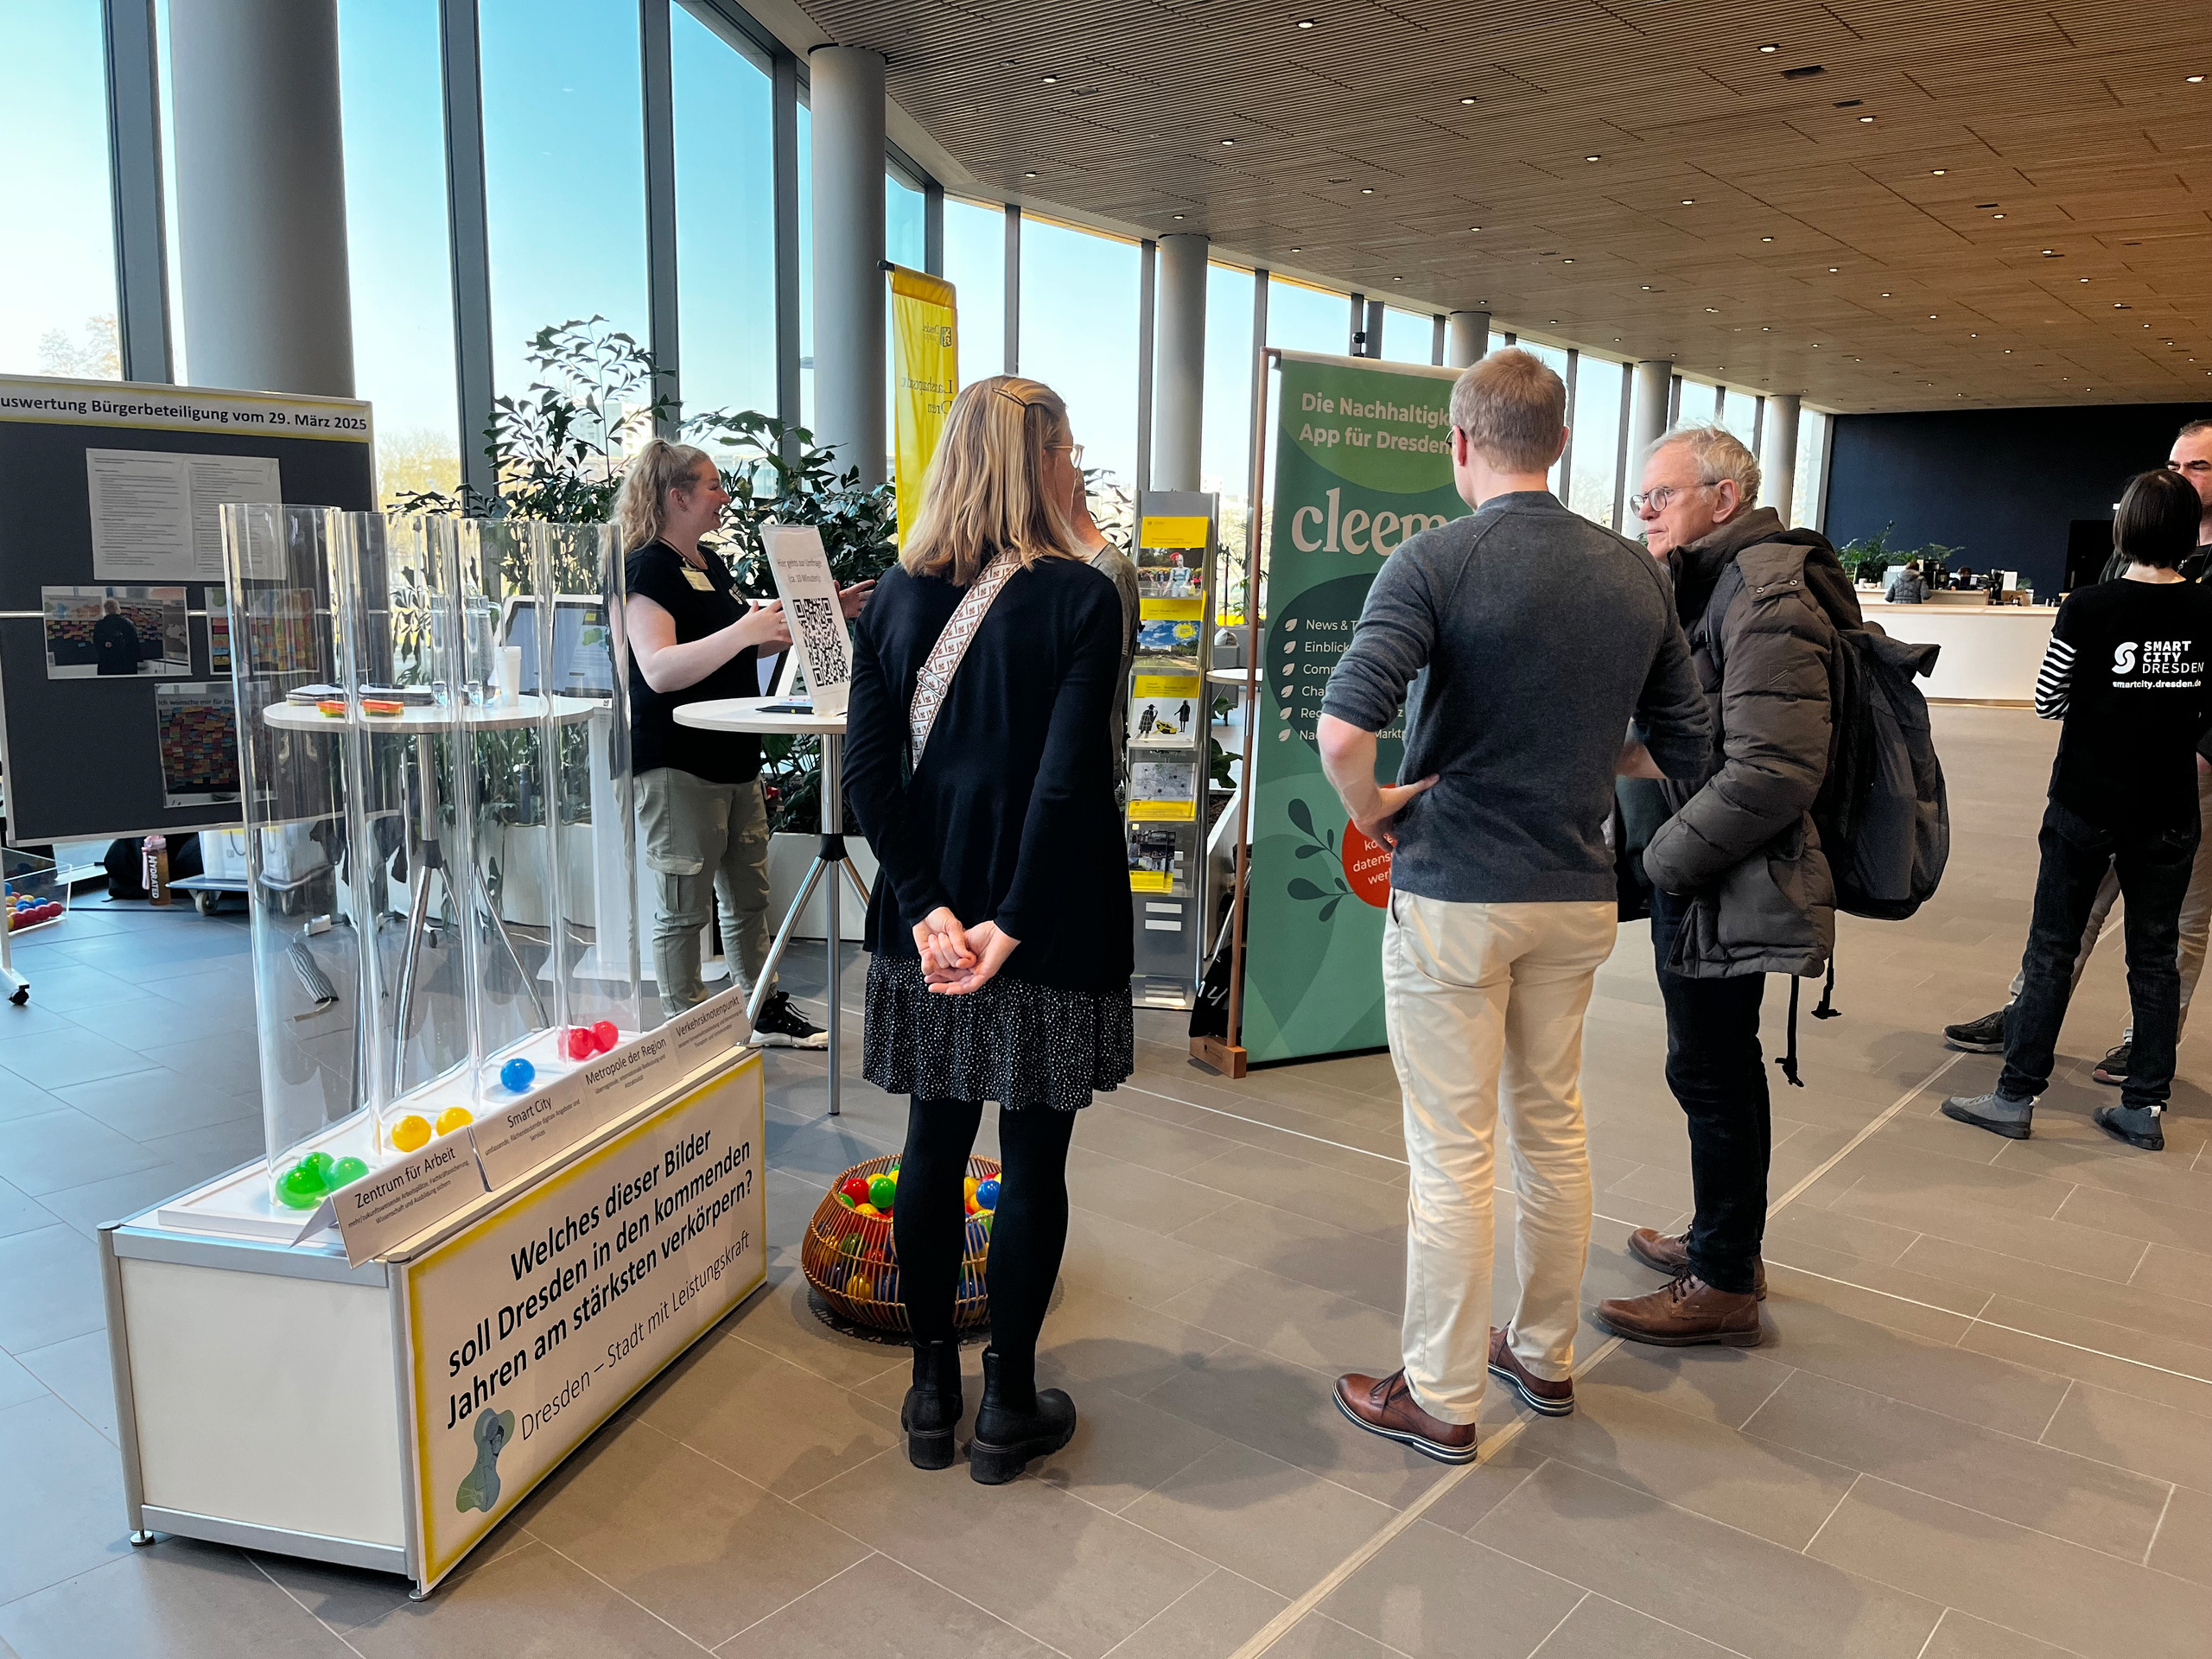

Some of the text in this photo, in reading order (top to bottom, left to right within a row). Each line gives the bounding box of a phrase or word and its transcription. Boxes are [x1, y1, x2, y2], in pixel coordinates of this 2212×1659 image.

[0, 397, 367, 430] uswertung Bürgerbeteiligung vom 29. März 2025
[1301, 391, 1335, 414] Die
[1299, 423, 1450, 454] App für Dresden
[1306, 620, 1338, 630] News
[1340, 620, 1348, 630] &
[2143, 652, 2181, 663] CITY
[2144, 640, 2191, 652] SMART
[2142, 662, 2204, 674] DRESDEN
[2113, 679, 2201, 690] smartcity.dresden.de
[1375, 728, 1406, 740] Markt
[148, 855, 160, 899] HYDRATED
[1352, 852, 1393, 873] datens
[675, 995, 741, 1037] Verkehrsknotenpunkt
[585, 1039, 667, 1086] Metropole der Region
[507, 1096, 552, 1128] Smart City
[354, 1147, 455, 1208] Zentrum für Arbeit
[511, 1129, 711, 1281] Welches dieser Bilder
[449, 1141, 750, 1377] soll Dresden in den kommenden
[447, 1169, 753, 1430] Jahren am stärksten verkörpern?
[521, 1371, 590, 1441] Dresden
[607, 1322, 645, 1368] Stadt
[648, 1301, 670, 1334] mit
[671, 1230, 750, 1313] Leistungskraft
